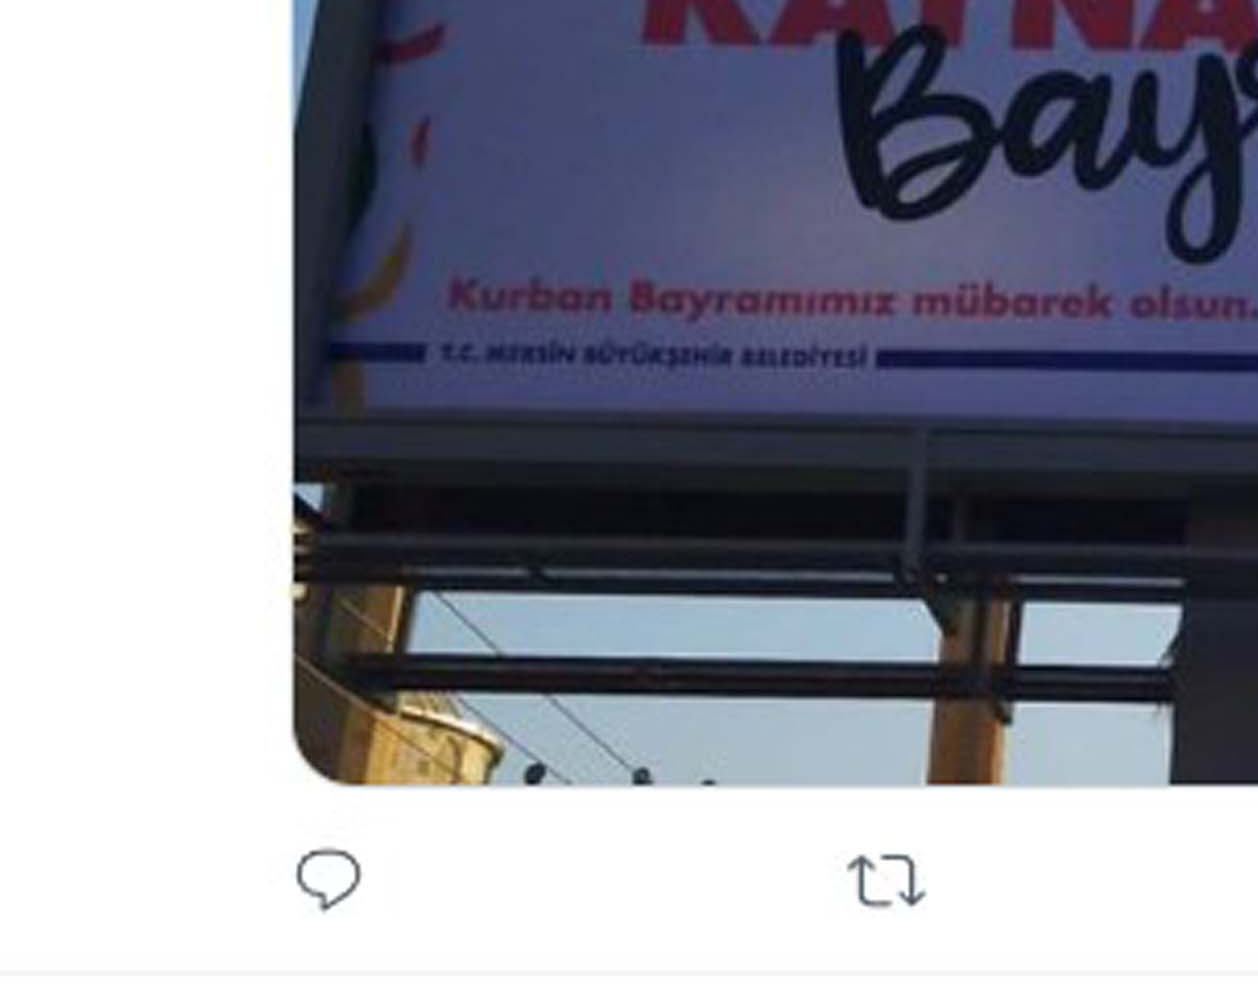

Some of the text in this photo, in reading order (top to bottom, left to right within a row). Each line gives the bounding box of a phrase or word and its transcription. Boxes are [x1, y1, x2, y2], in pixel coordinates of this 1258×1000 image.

[447, 278, 614, 315] Kurban
[630, 279, 896, 324] Bayramımız
[911, 283, 1114, 320] mübarek
[440, 342, 868, 370] T.C. MERSİN BÜYÜKŞEHİR BELEDİYESİ
